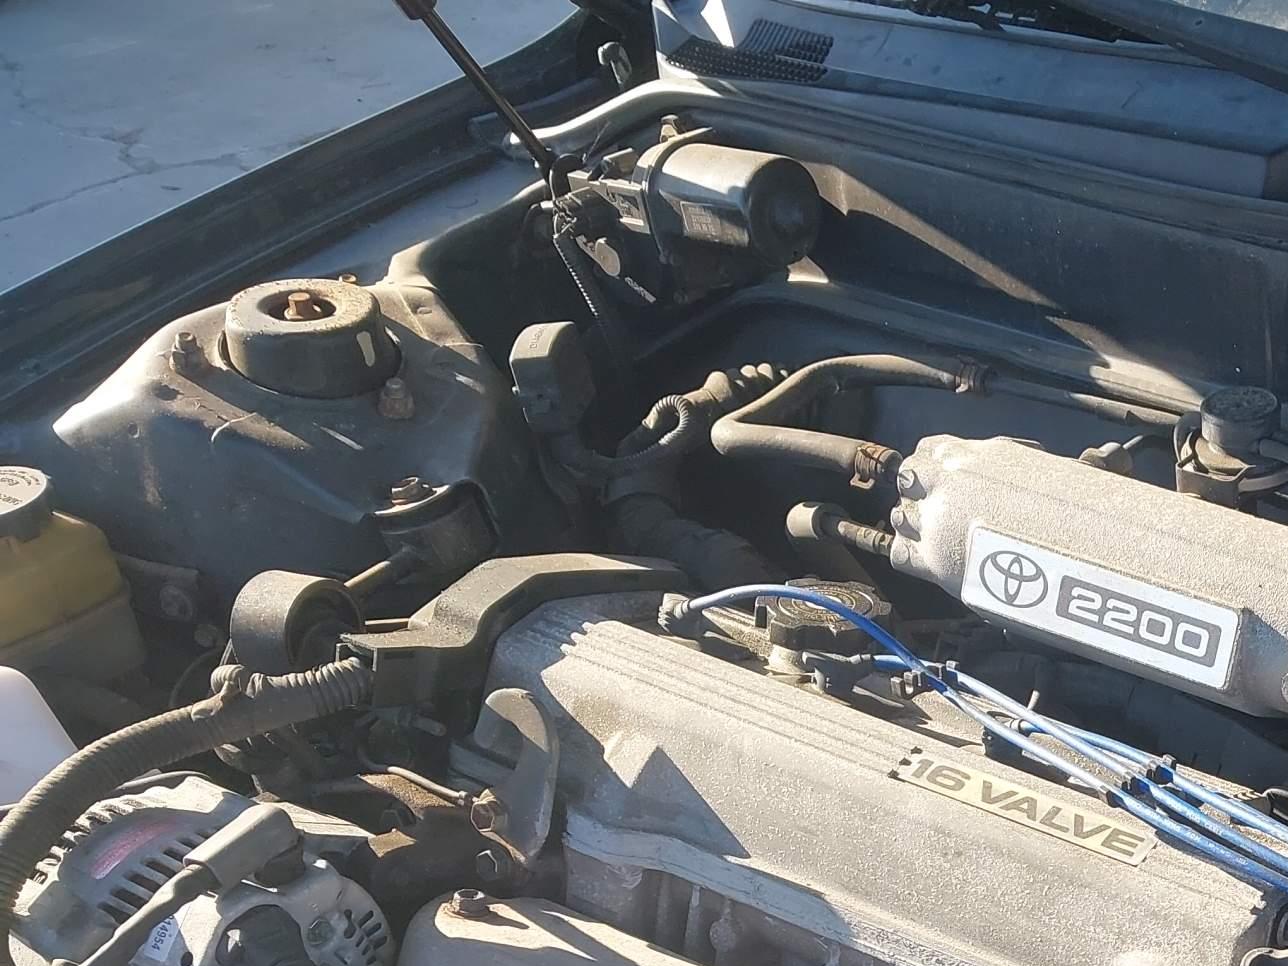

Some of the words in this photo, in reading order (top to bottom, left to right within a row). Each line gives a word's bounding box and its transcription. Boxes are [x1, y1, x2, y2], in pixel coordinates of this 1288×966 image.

[1068, 586, 1211, 658] 2200
[911, 759, 972, 796] 16
[981, 780, 1145, 859] VALVE
